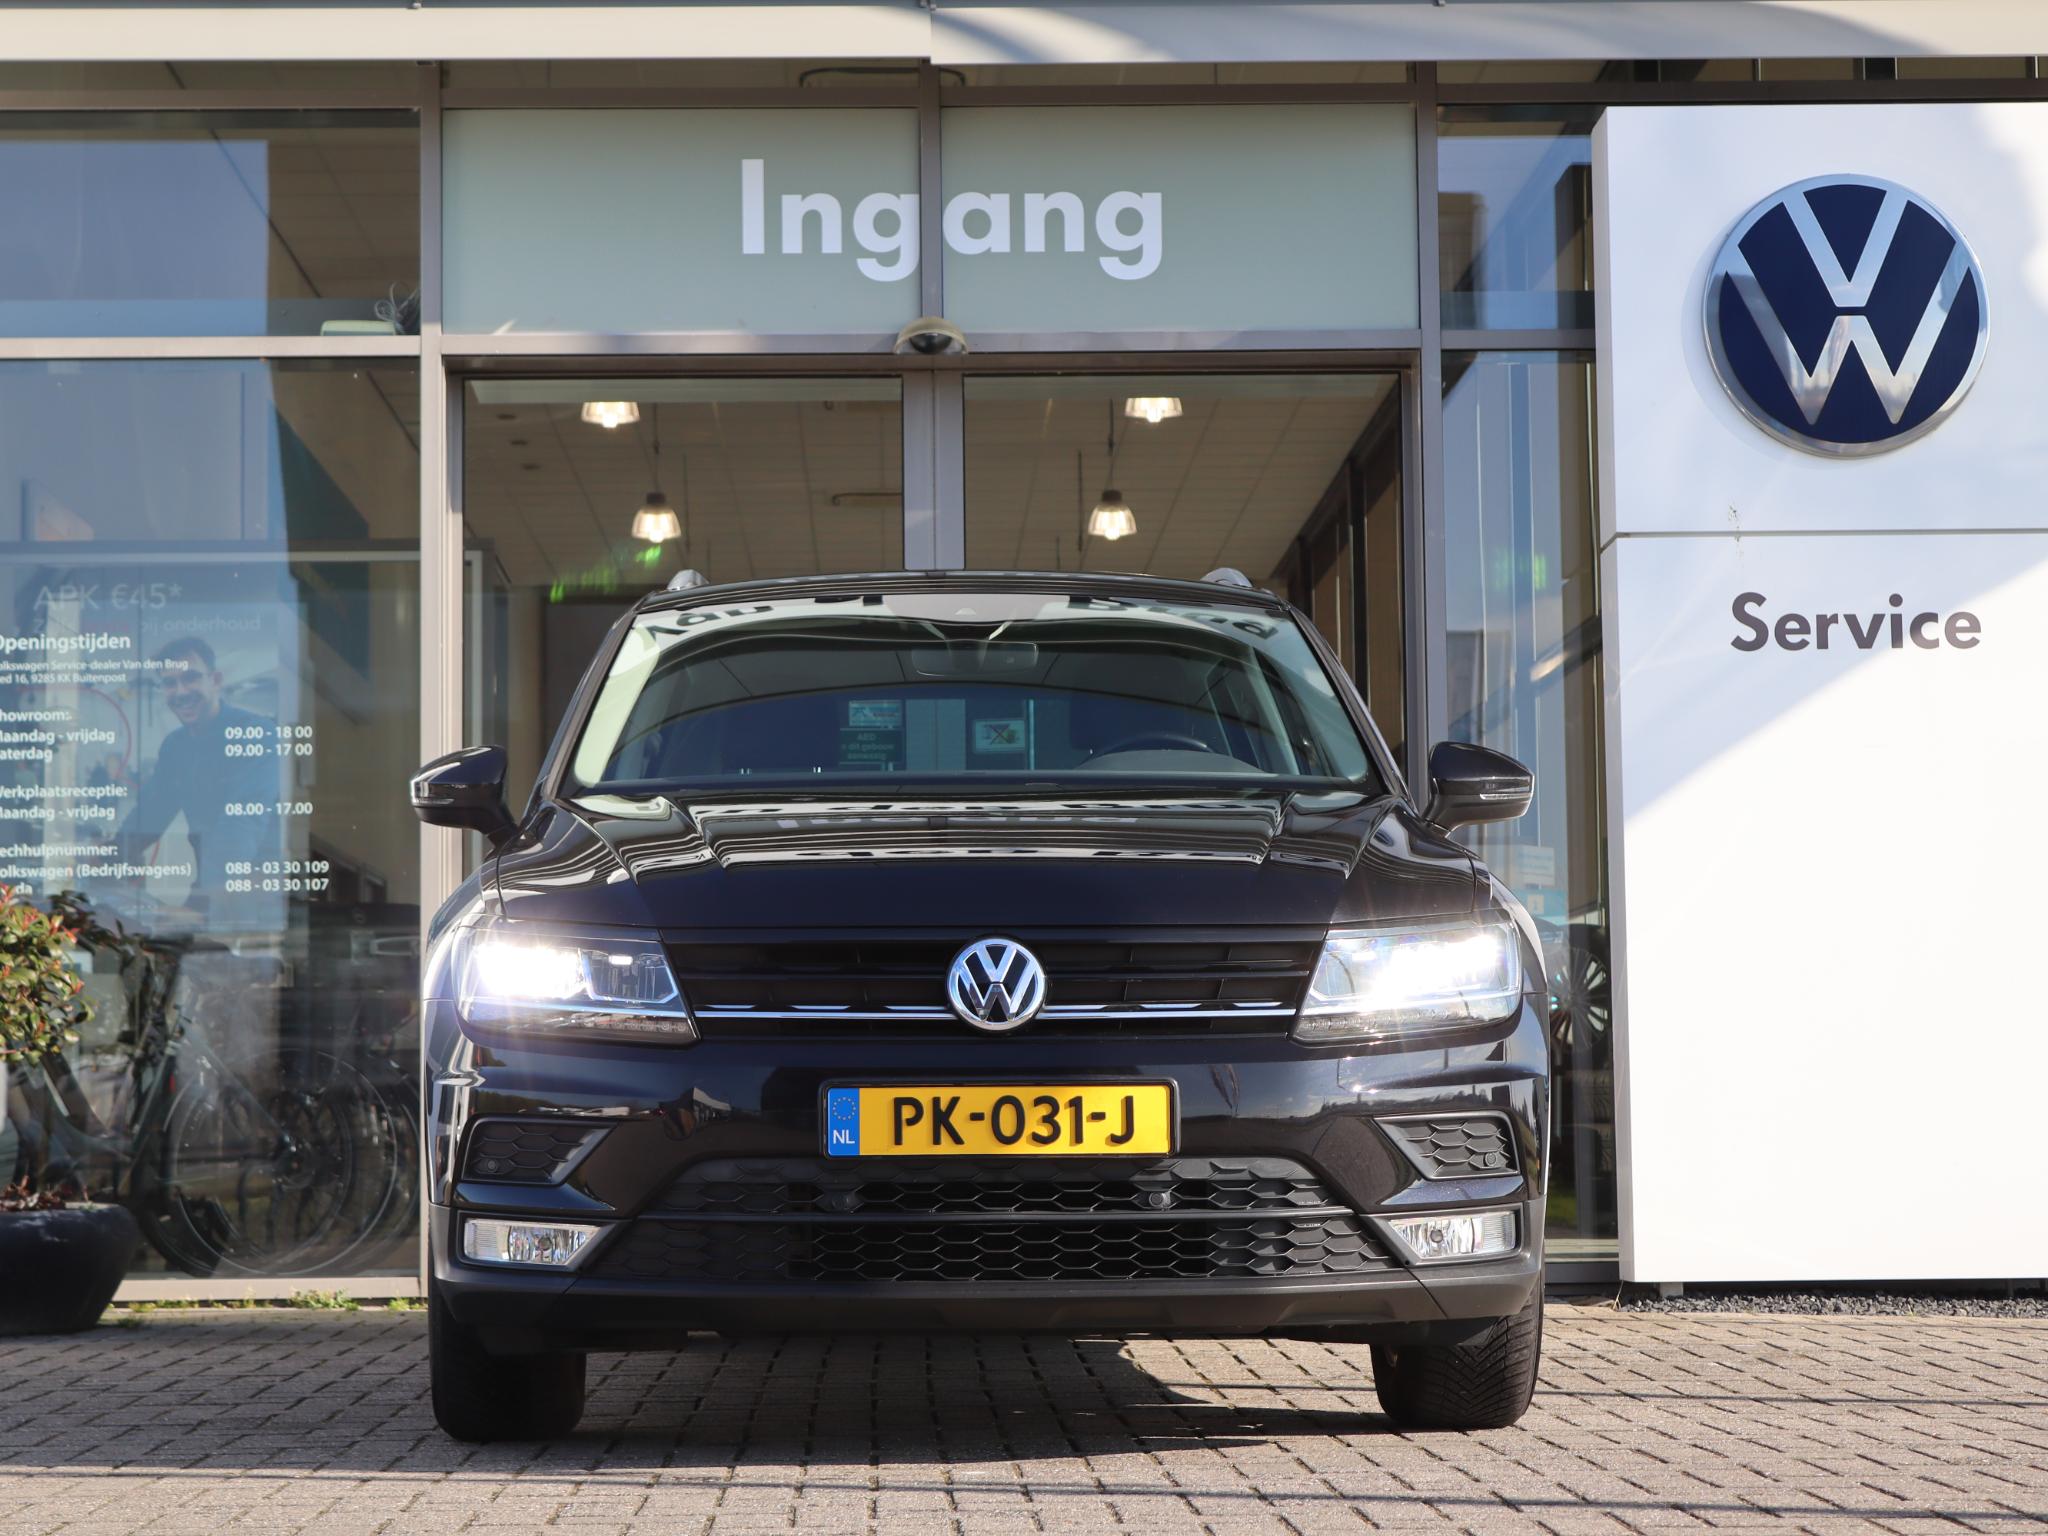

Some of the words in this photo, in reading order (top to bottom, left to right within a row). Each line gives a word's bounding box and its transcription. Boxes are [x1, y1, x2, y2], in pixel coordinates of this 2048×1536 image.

[741, 158, 1163, 282] Ingang
[33, 584, 100, 611] APK
[163, 614, 262, 633] onderhoud
[1731, 591, 1982, 653] Service
[143, 658, 163, 670] den
[164, 658, 189, 672] Brug
[73, 671, 127, 685] Buitenpost
[66, 728, 116, 744] vrijdag
[224, 726, 264, 740] 09.00
[224, 743, 264, 757] 09.00
[66, 804, 116, 821] vrijdag
[225, 802, 265, 816] 08.00
[275, 801, 314, 815] 17.00
[76, 862, 192, 880] (Bedrijfswagens)
[225, 861, 252, 875] 088
[262, 861, 280, 875] 03
[283, 860, 301, 874] 30
[304, 860, 330, 874] 109
[225, 878, 252, 892] 088
[262, 878, 280, 892] 03
[283, 878, 301, 892] 30
[304, 877, 330, 891] 107
[892, 1094, 1135, 1146] PK-031-J
[832, 1129, 856, 1145] NL
